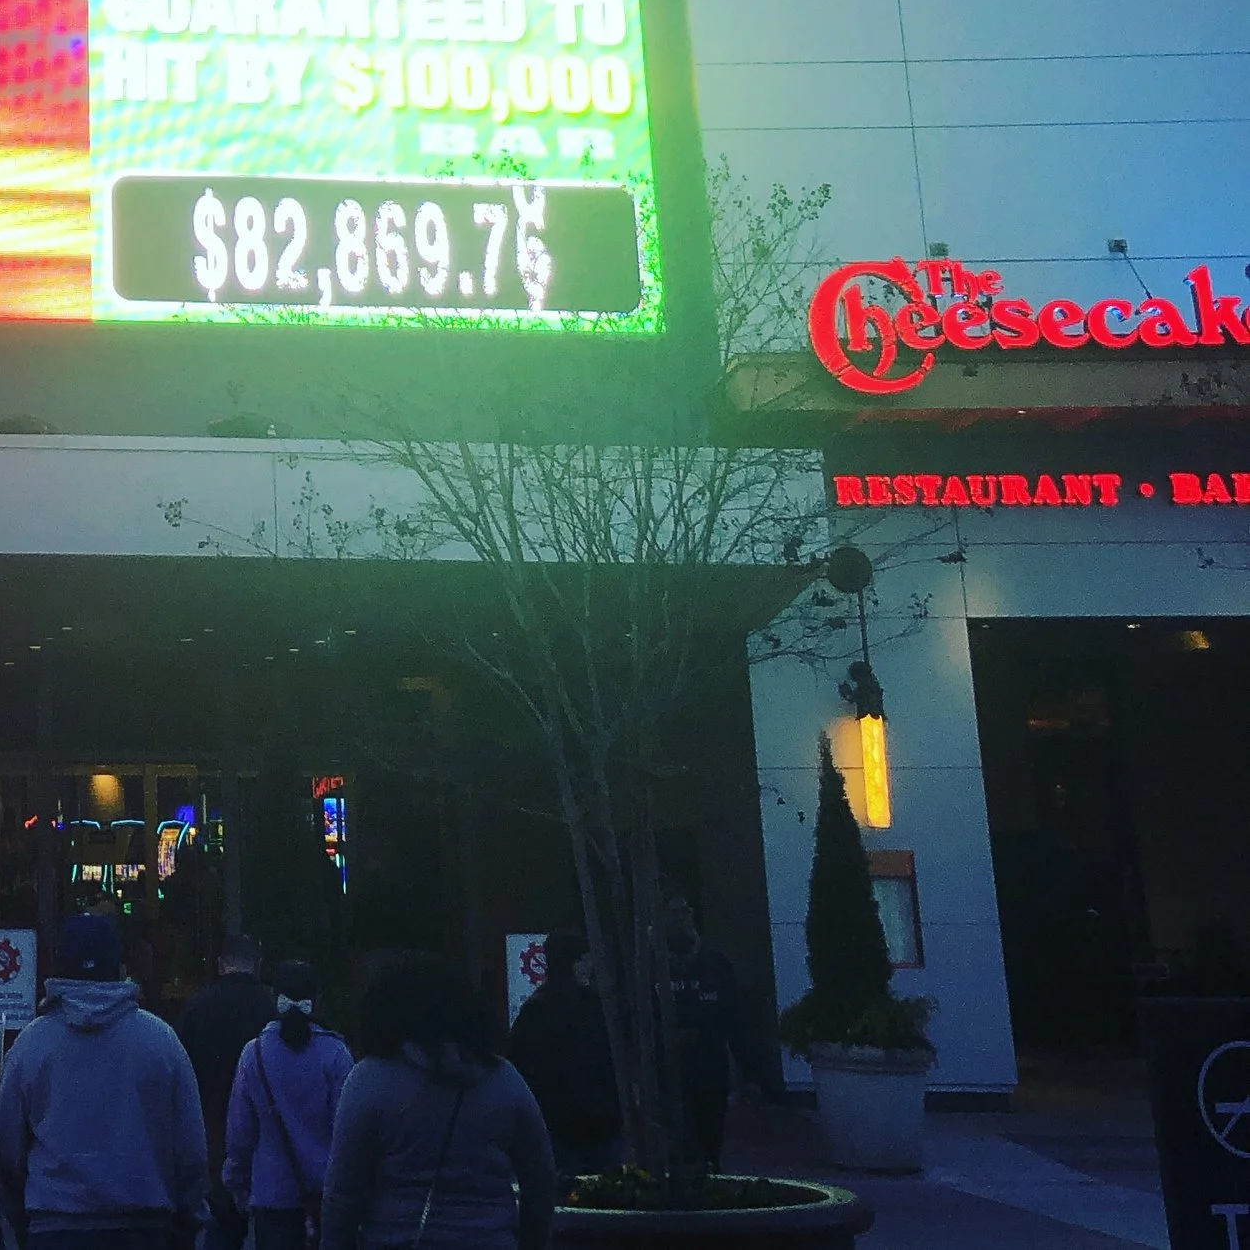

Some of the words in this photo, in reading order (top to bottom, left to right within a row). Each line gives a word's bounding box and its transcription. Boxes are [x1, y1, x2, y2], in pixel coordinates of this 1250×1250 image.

[103, 41, 206, 102] HIT
[224, 43, 312, 106] BY
[334, 49, 633, 123] $100,000
[917, 256, 1004, 302] The
[809, 257, 1250, 395] Cheesecak
[833, 472, 1122, 507] RESTAURANT
